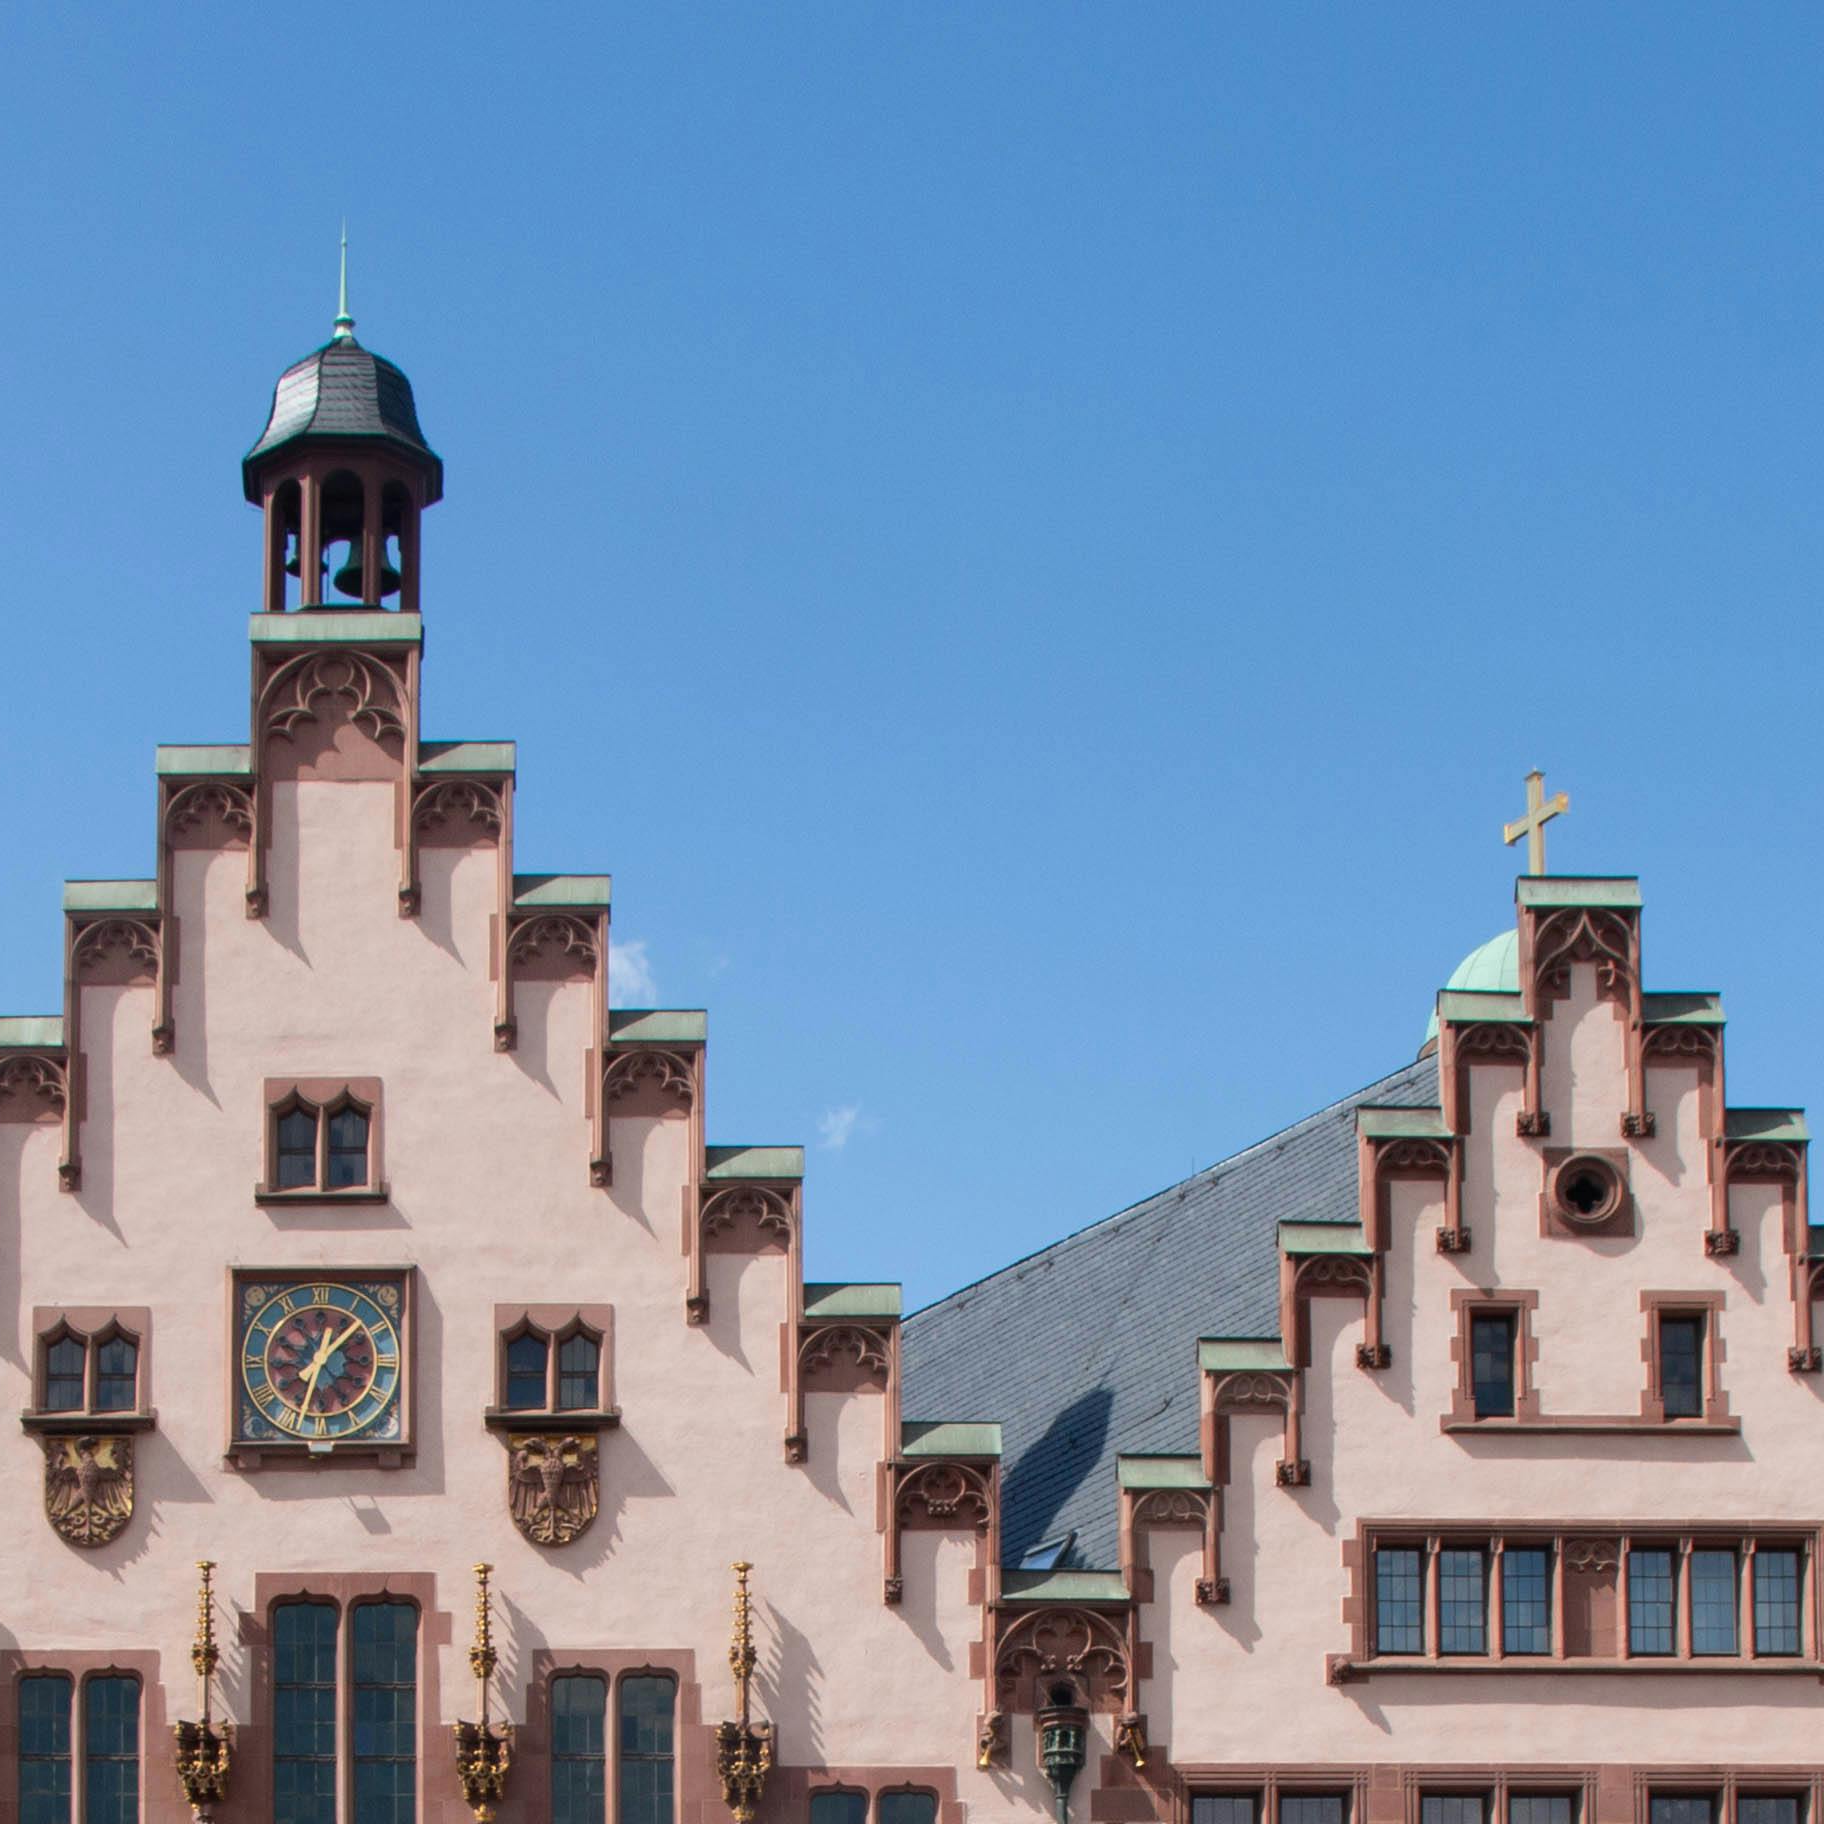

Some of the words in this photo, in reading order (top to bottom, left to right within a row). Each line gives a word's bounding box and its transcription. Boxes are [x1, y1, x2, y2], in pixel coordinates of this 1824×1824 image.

[312, 1287, 330, 1304] XII
[278, 1295, 296, 1314] XI
[254, 1321, 272, 1336] X
[369, 1321, 388, 1335] II
[377, 1354, 398, 1367] III
